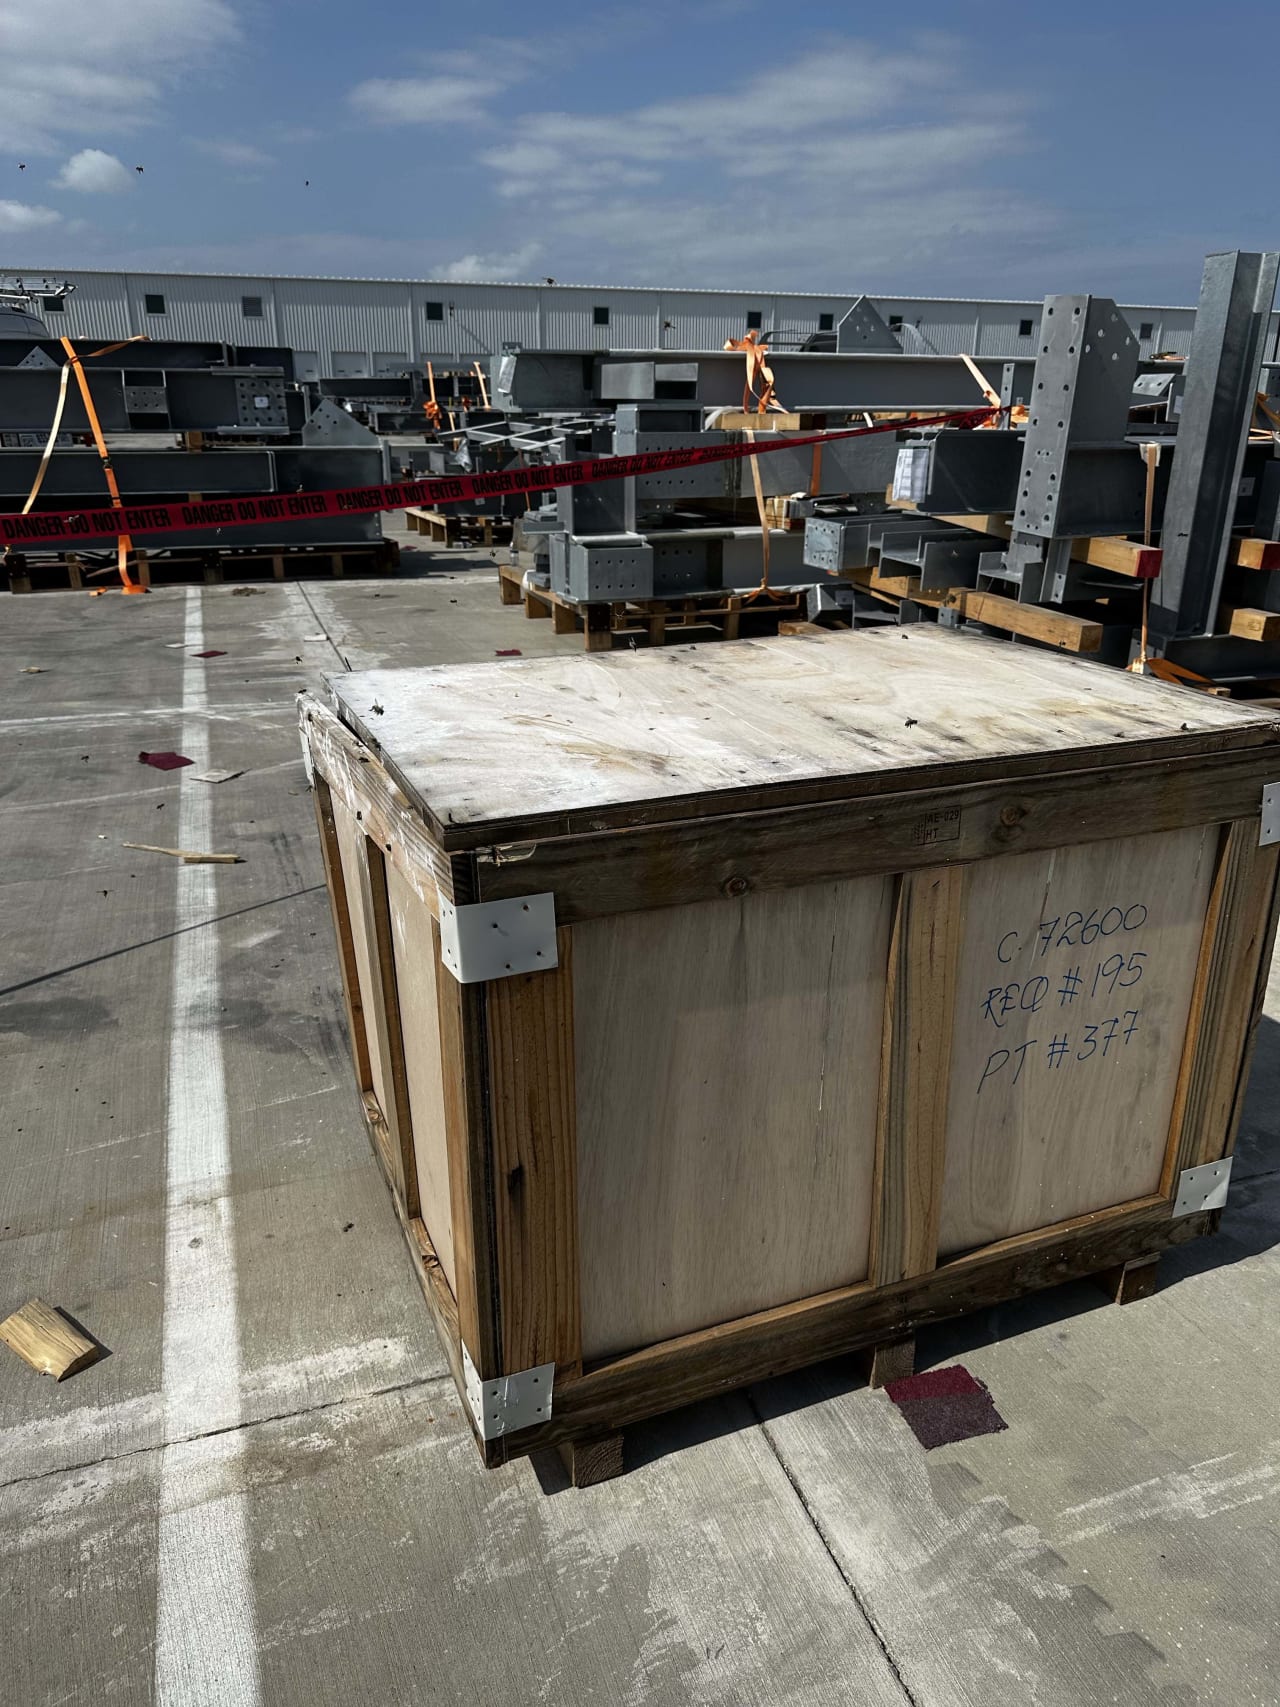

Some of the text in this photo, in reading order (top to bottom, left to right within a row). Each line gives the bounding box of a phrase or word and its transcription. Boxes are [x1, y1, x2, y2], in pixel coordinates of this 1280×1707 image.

[471, 465, 583, 495] DANGER DO NOT ENTER
[592, 460, 627, 478] DANGER
[630, 457, 643, 472] DO
[645, 454, 664, 470] NOT
[182, 495, 328, 525] DANGER DO NOT ENTER
[336, 481, 464, 510] DANGER DO NOT ENTER
[2, 508, 172, 539] DANGER DO NOT ENTER
[926, 828, 939, 841] HT
[1039, 903, 1148, 957] 72600
[980, 976, 1049, 1028] REQ
[976, 1039, 1038, 1094] PT
